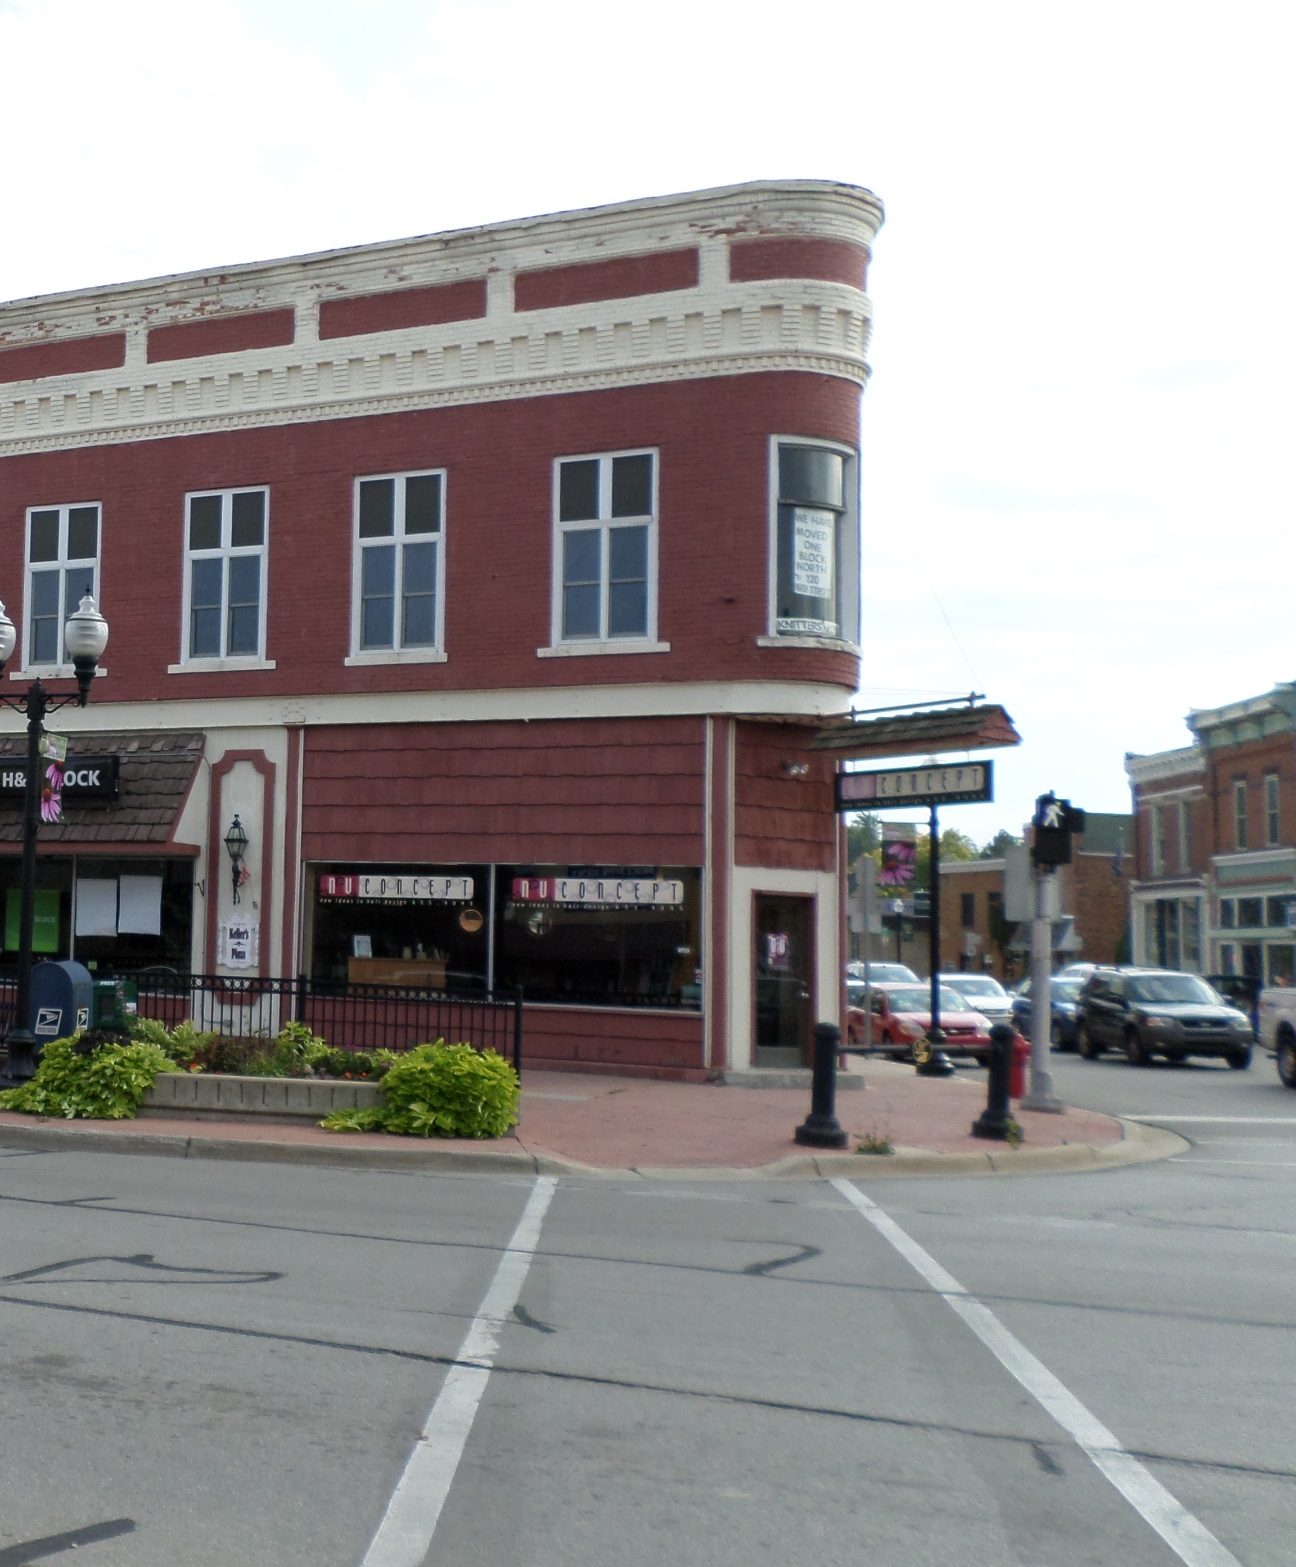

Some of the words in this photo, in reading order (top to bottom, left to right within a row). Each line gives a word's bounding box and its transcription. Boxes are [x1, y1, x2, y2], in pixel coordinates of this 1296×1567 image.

[804, 541, 823, 553] ONE
[2, 771, 27, 788] H&
[61, 769, 101, 787] OCK
[880, 768, 980, 794] CONCEPT
[365, 879, 468, 896] CONCEPT
[561, 881, 678, 901] CONCEPT
